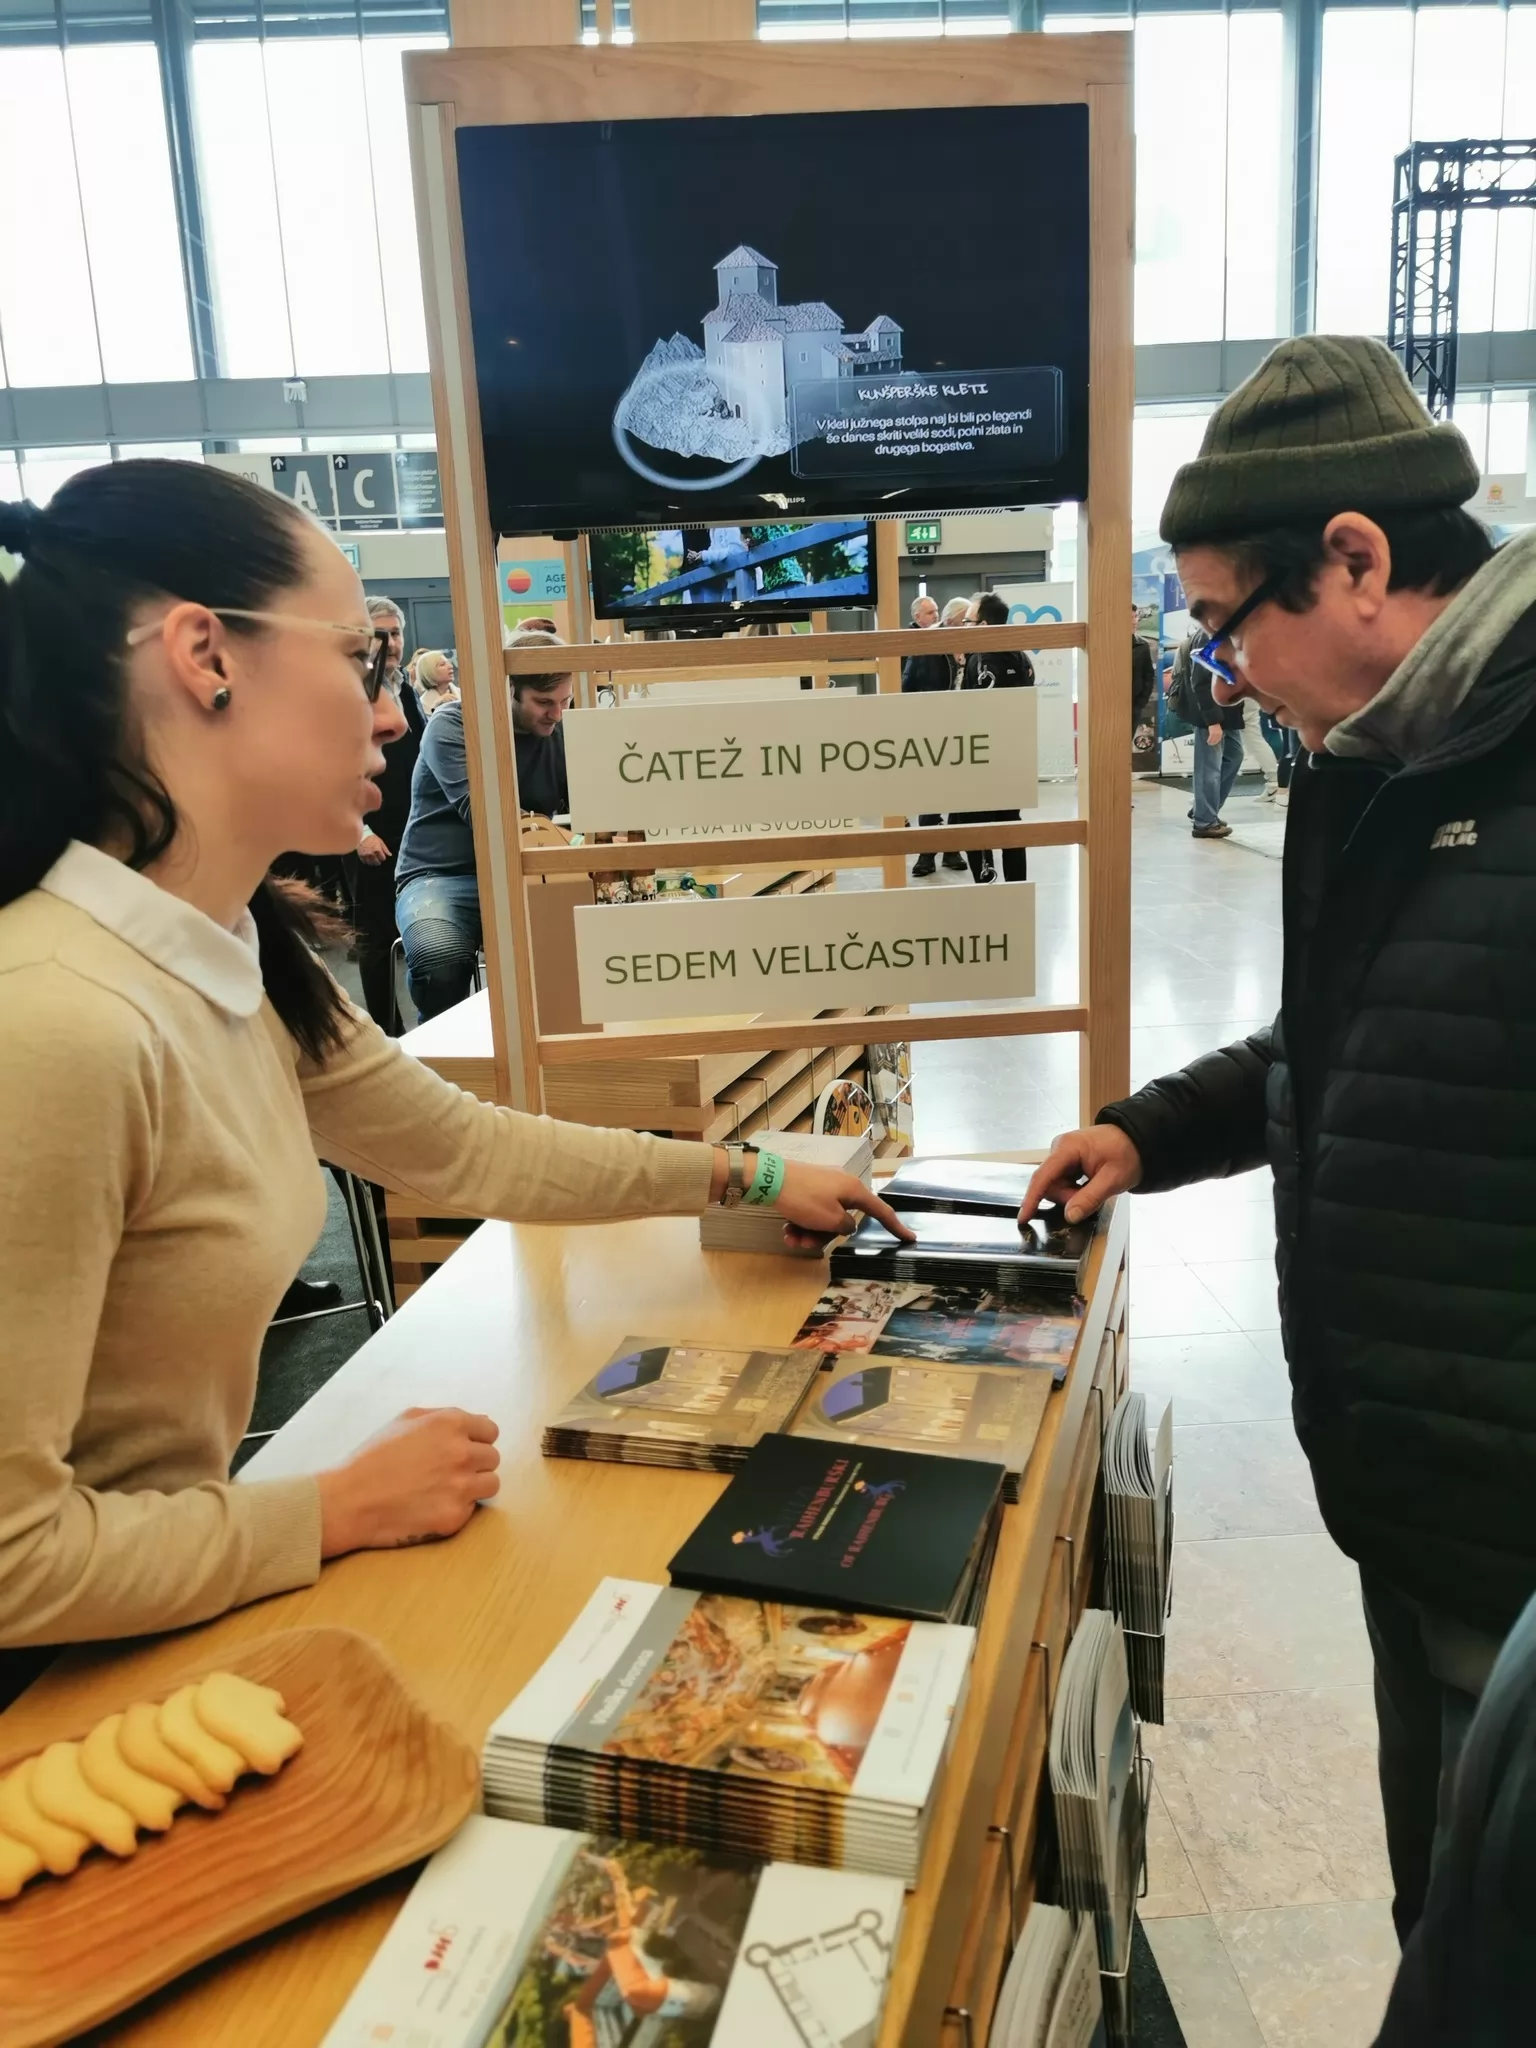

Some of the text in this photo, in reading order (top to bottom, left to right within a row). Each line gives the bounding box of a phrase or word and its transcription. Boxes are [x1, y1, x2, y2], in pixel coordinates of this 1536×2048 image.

[858, 383, 988, 400] KUNŠPERŠKE KLETI
[816, 408, 1032, 432] V kleti južnega stolpa naj bi bili po legendi
[826, 423, 1023, 443] še danes skriti veliki sodi, polni zlata in
[875, 440, 975, 456] drugega bogastva.
[294, 470, 317, 510] A
[353, 469, 375, 509] C
[618, 733, 991, 784] ČATEŽ IN POSAVJE
[604, 931, 1010, 985] SEDEM VELIČASTNIH
